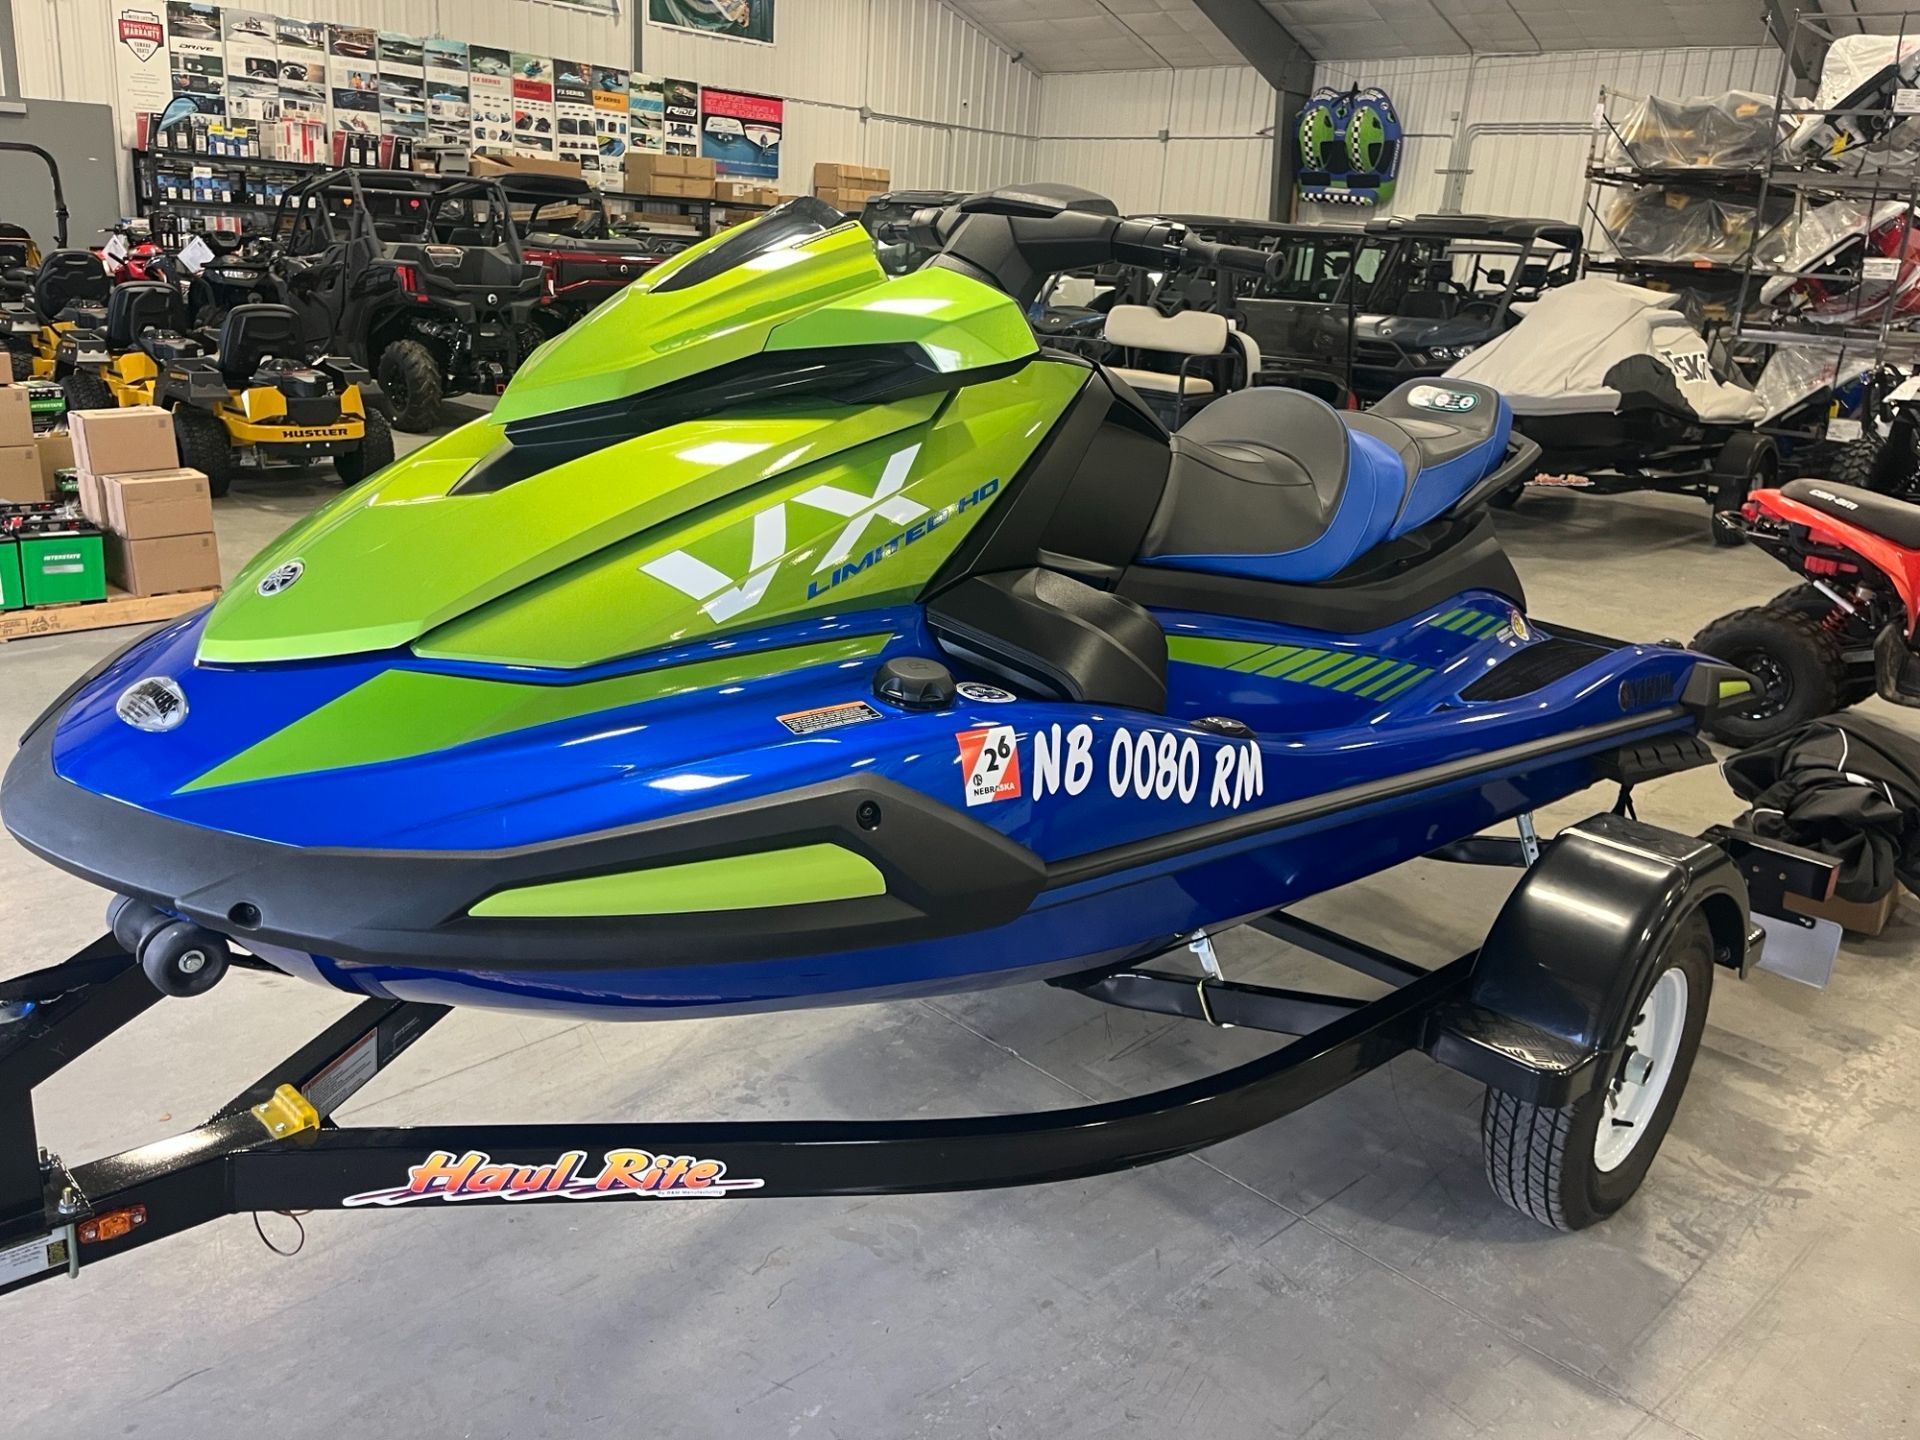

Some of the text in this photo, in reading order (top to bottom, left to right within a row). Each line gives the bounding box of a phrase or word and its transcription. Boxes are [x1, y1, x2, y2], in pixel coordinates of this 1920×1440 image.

[123, 28, 160, 39] WARRANTY
[565, 89, 585, 97] SERIES
[282, 428, 348, 438] HUSTLER
[637, 443, 930, 624] VX
[806, 477, 999, 600] LIMITED HO
[43, 553, 81, 561] INTERSTATE
[984, 735, 1011, 772] 26
[1032, 723, 1263, 809] NB 0080 RM
[973, 782, 1016, 796] NEBRASKA
[410, 1149, 724, 1193] Haul Rite
